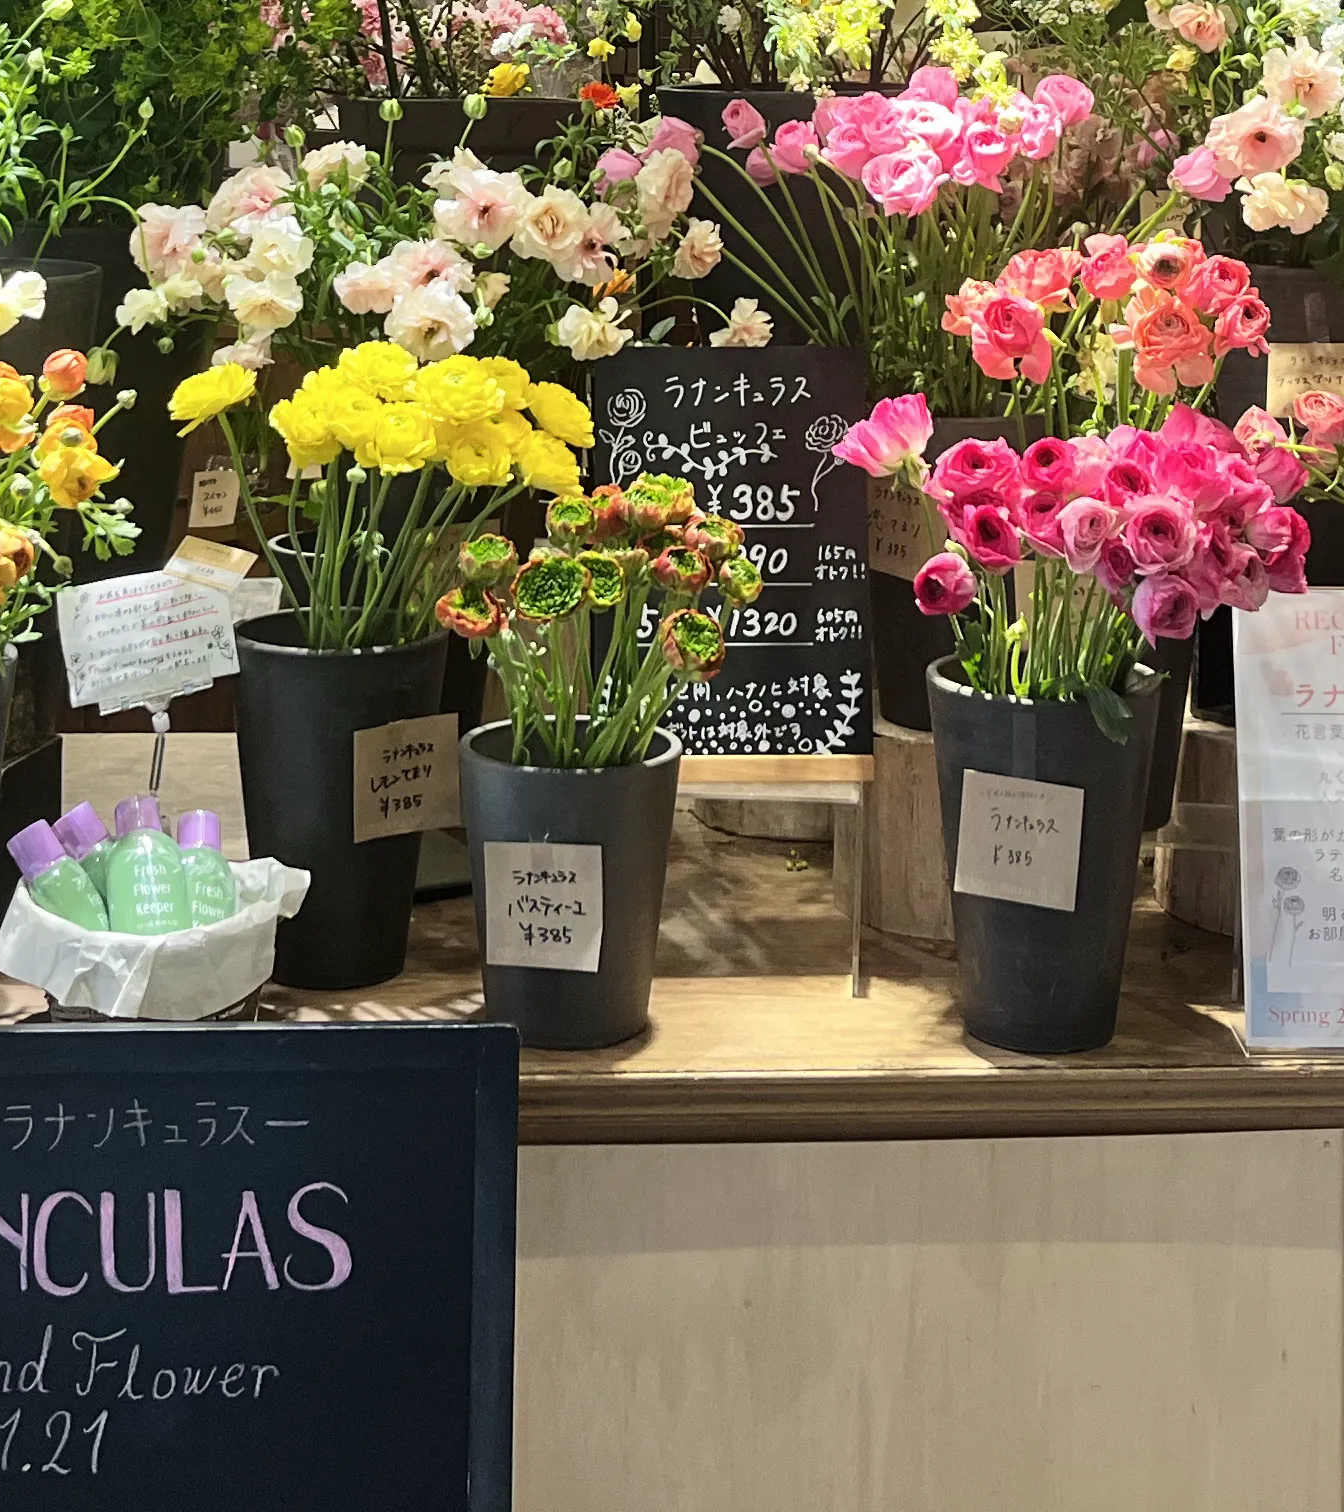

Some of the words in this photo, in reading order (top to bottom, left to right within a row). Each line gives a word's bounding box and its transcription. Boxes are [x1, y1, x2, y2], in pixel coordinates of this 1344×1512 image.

[663, 372, 812, 408] ラナンキュラス
[689, 421, 787, 449] ビュッフェ
[707, 483, 801, 521] ¥385
[736, 544, 788, 575] 90
[380, 794, 423, 819] ¥385
[990, 807, 1060, 834] ラナンキュラス
[993, 844, 1033, 866] ¥385
[134, 863, 167, 876] Fresh
[512, 870, 577, 886] ラナンキュラス
[133, 883, 172, 896] Flower
[195, 881, 224, 901] Fresh
[135, 901, 175, 916] Keeper
[518, 921, 573, 946] ¥385
[1268, 1004, 1330, 1027] Spring
[71, 1327, 281, 1402] Flower
